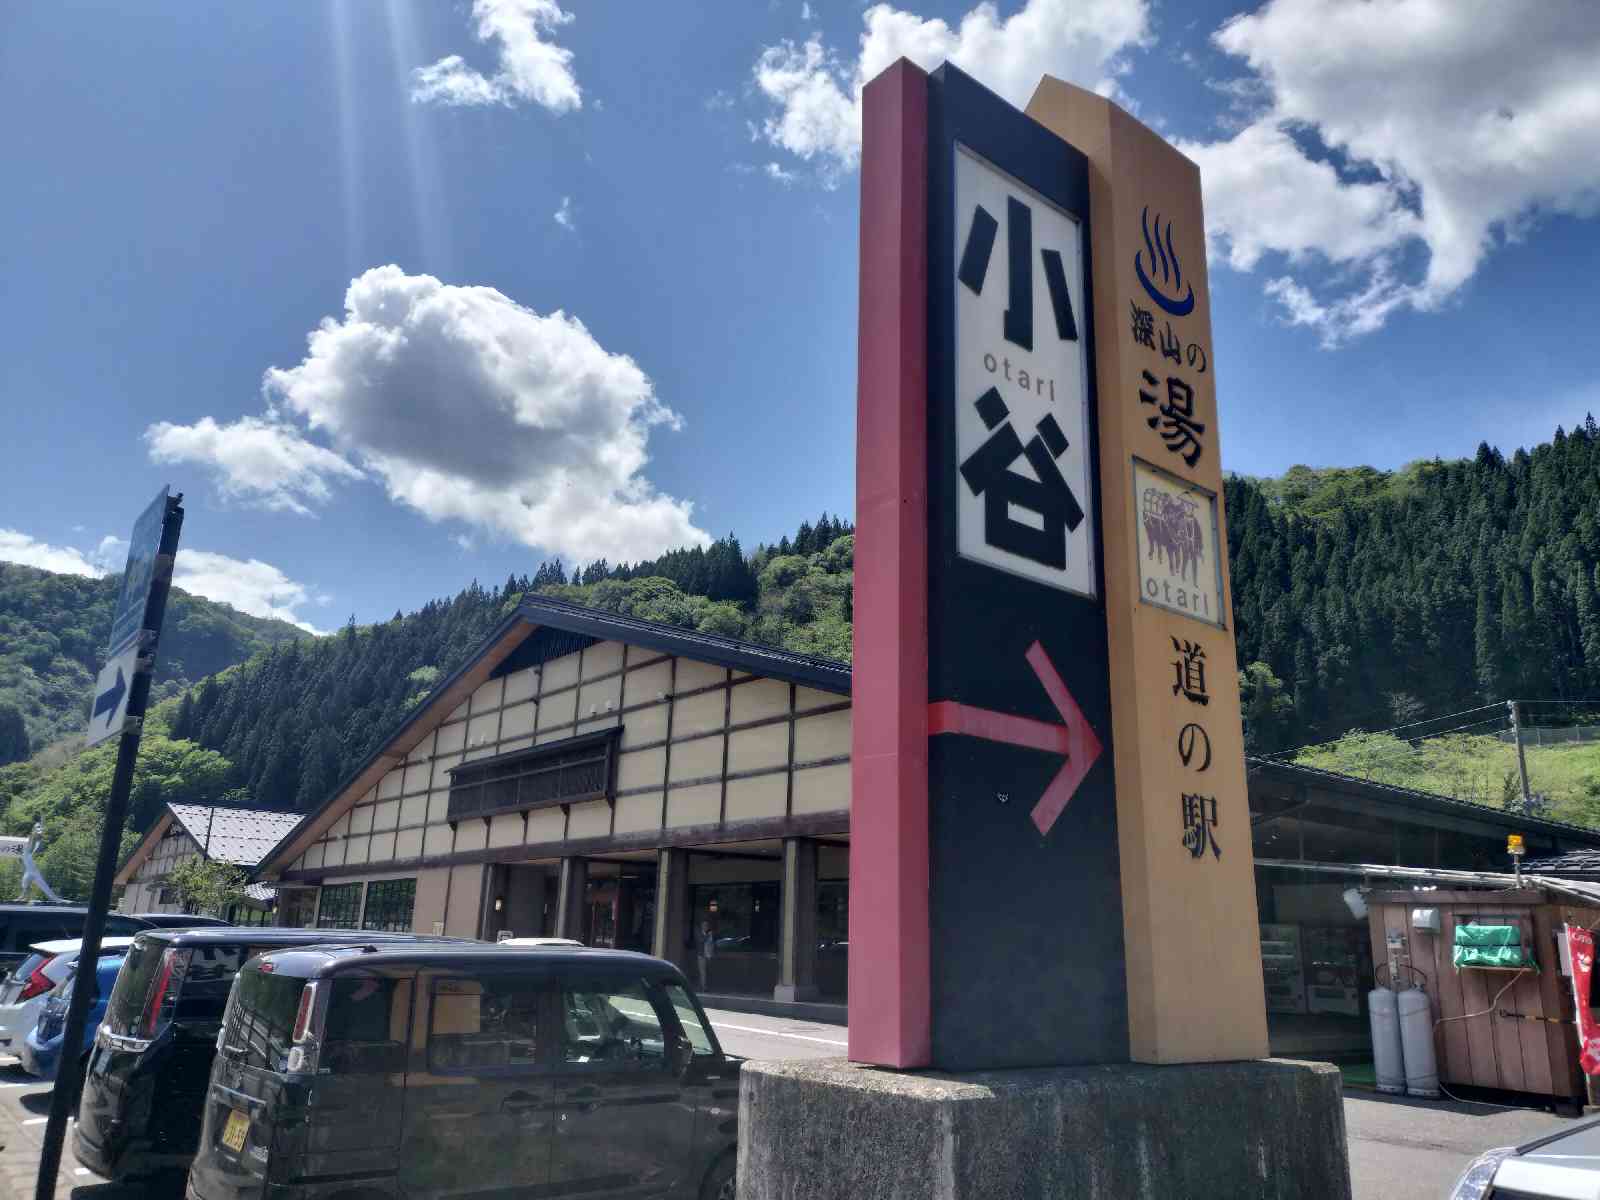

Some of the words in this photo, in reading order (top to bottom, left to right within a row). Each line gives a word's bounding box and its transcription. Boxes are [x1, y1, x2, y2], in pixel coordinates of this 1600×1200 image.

[983, 353, 1055, 402] otari
[1146, 578, 1209, 617] otari
[1171, 635, 1222, 861] 道の駅
